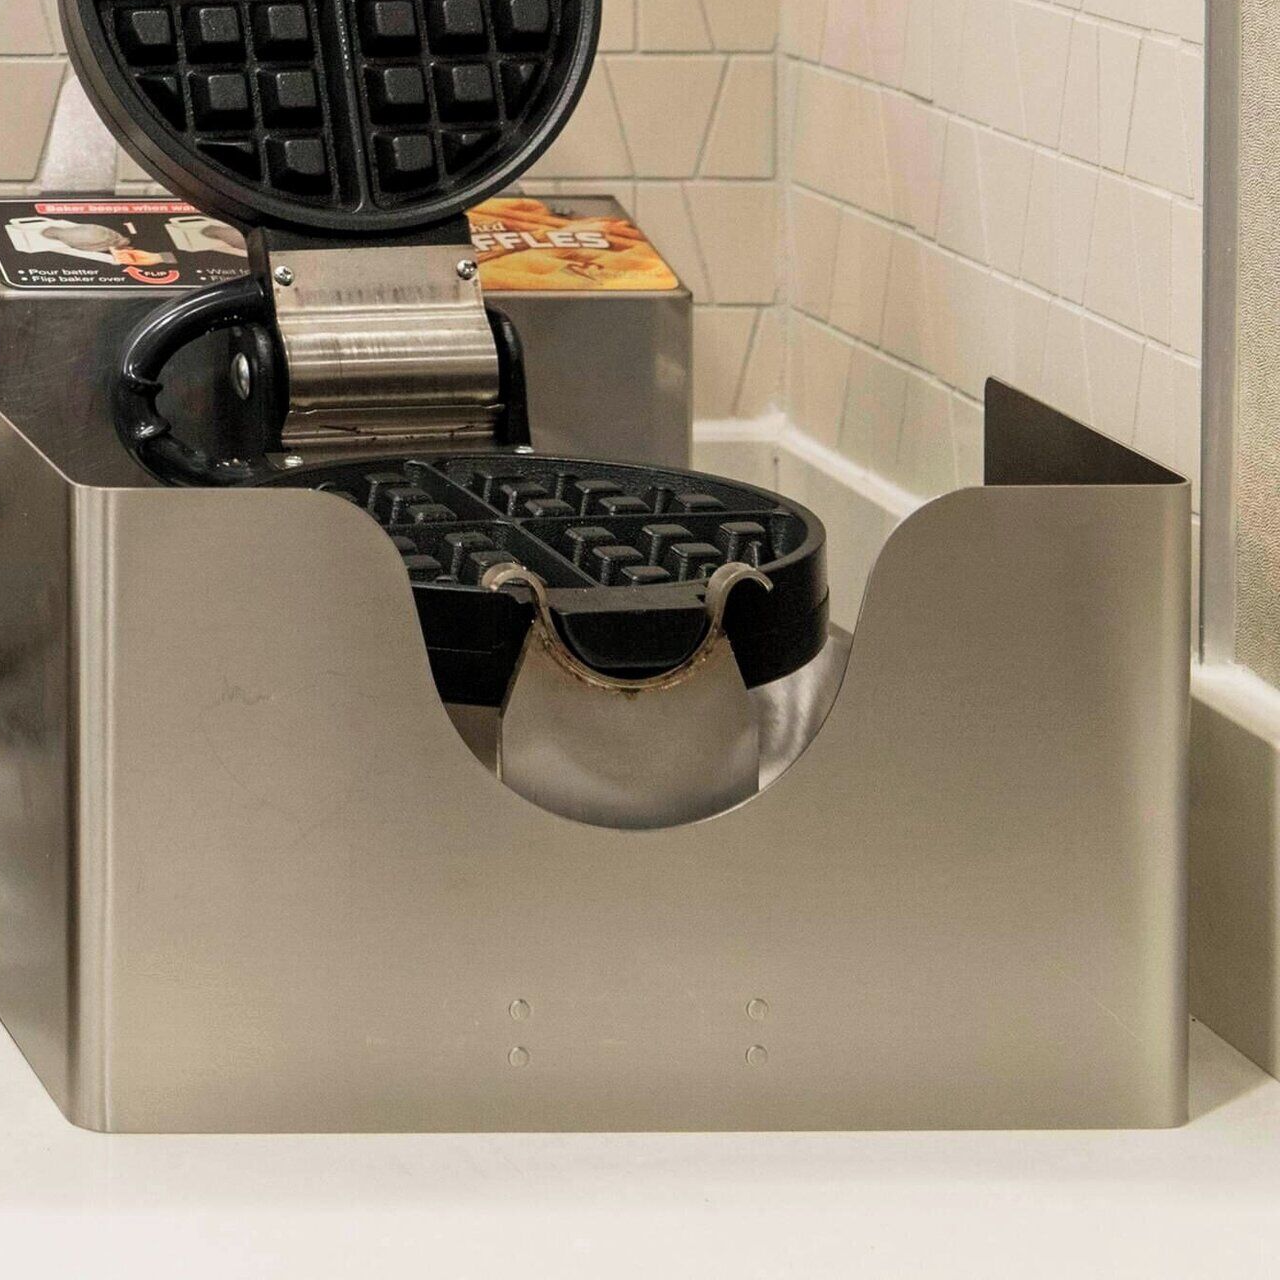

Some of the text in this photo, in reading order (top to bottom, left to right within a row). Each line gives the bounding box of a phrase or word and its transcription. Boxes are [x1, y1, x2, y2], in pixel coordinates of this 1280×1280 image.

[46, 204, 85, 212] Baker
[88, 205, 129, 213] beeps
[132, 204, 169, 212] when
[125, 222, 137, 235] 1
[473, 231, 611, 252] FFLES
[32, 275, 56, 284] Flip
[59, 275, 96, 283] baker
